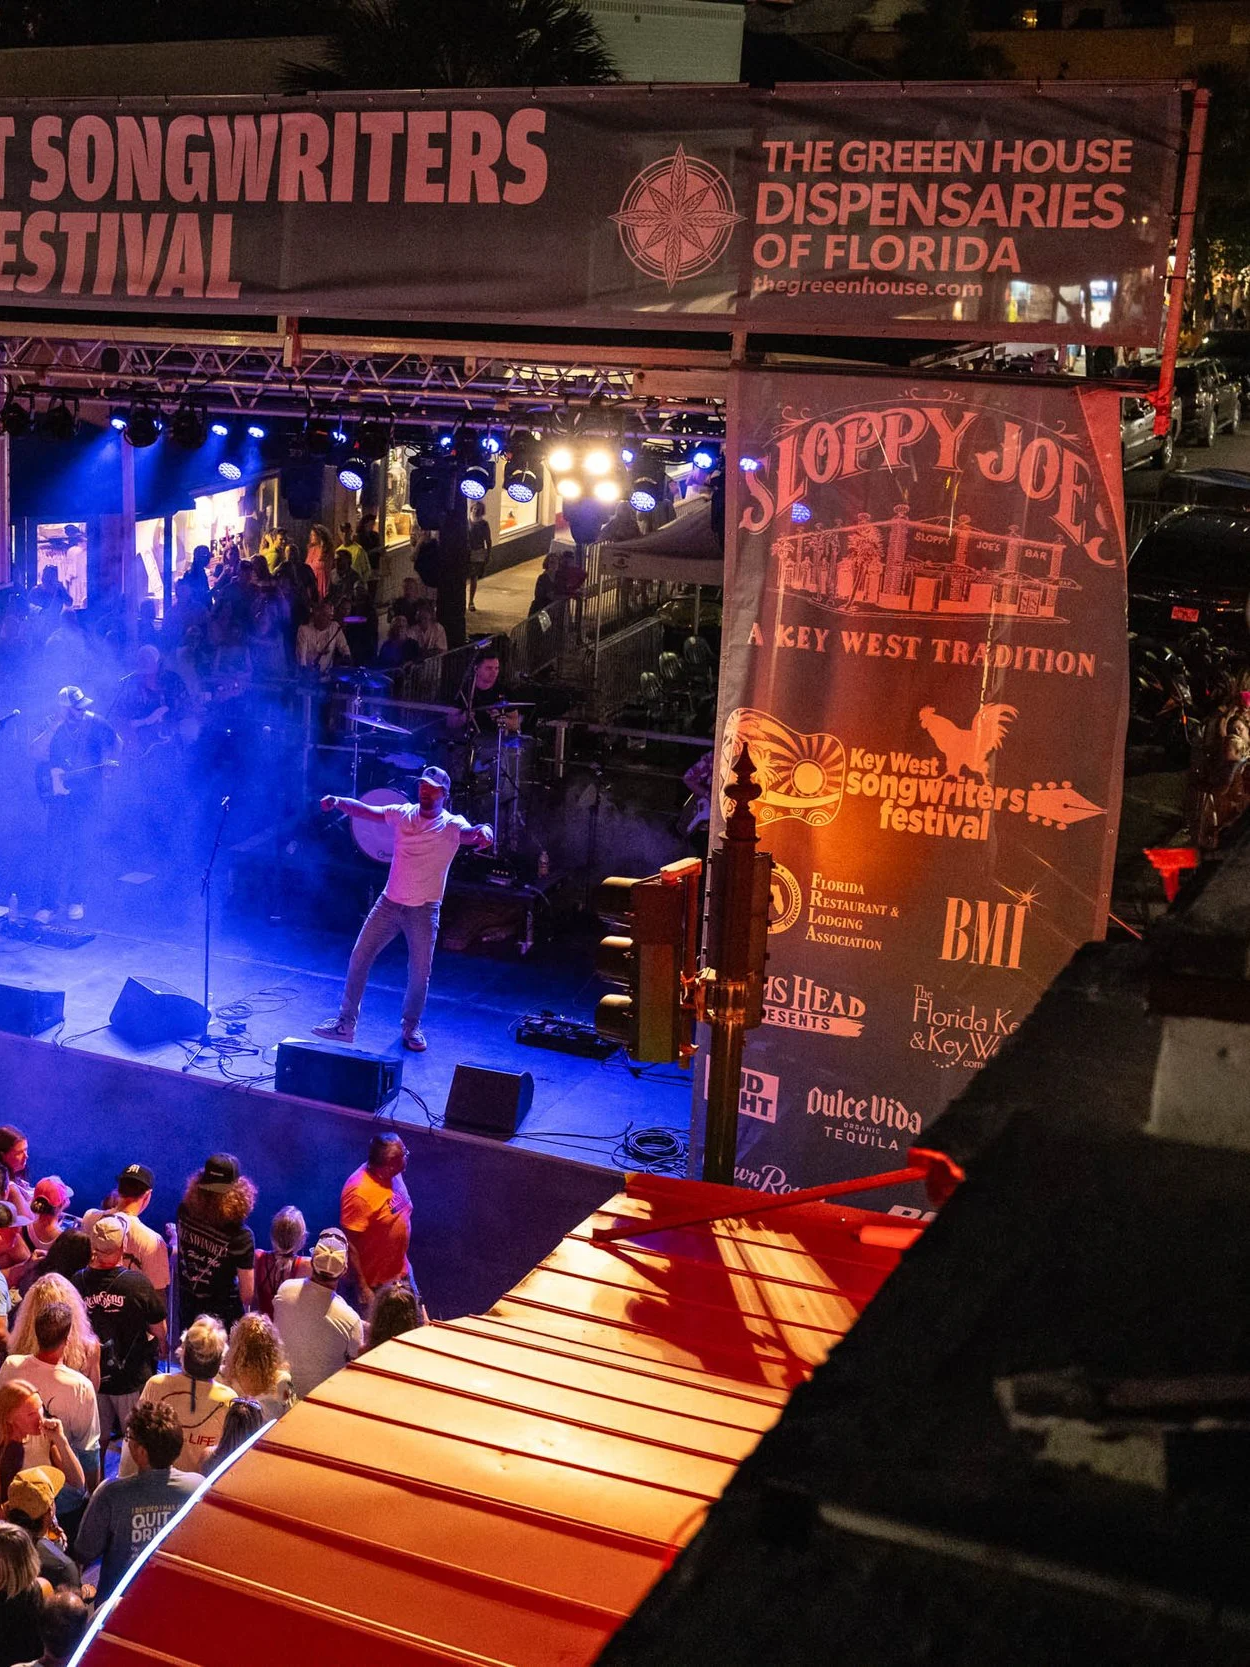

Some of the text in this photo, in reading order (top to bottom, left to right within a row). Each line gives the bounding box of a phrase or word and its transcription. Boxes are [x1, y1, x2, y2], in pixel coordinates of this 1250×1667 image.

[29, 107, 549, 206] SONGWRITERS
[763, 138, 1133, 174] THE GREEEN HOUSE
[754, 182, 1126, 230] DISPENSARIES
[752, 233, 1022, 274] OF FLORIDA
[753, 276, 984, 298] thegreeenhouse.com
[738, 405, 979, 535] SLOPPY
[914, 531, 1048, 561] SLOPPY JOE'S BAR
[747, 621, 1096, 678] A KEY WEST TRADITION
[850, 748, 940, 777] Key West
[845, 770, 1026, 814] songwriters
[879, 799, 992, 842] festival
[811, 872, 866, 895] FLORIDA
[810, 889, 900, 918] RESTAURANT &
[808, 906, 864, 931] LODGING
[938, 893, 1029, 971] BMI
[805, 924, 883, 951] ASSOCIATION
[791, 974, 867, 1018] HEAD
[913, 984, 934, 999] The
[766, 1008, 831, 1031] ESENTS
[912, 997, 988, 1033] Florida
[824, 1125, 899, 1152] TEQUILA
[843, 1121, 881, 1135] ORGANIC
[188, 1434, 216, 1448] LIFE
[131, 1511, 171, 1530] QUIT
